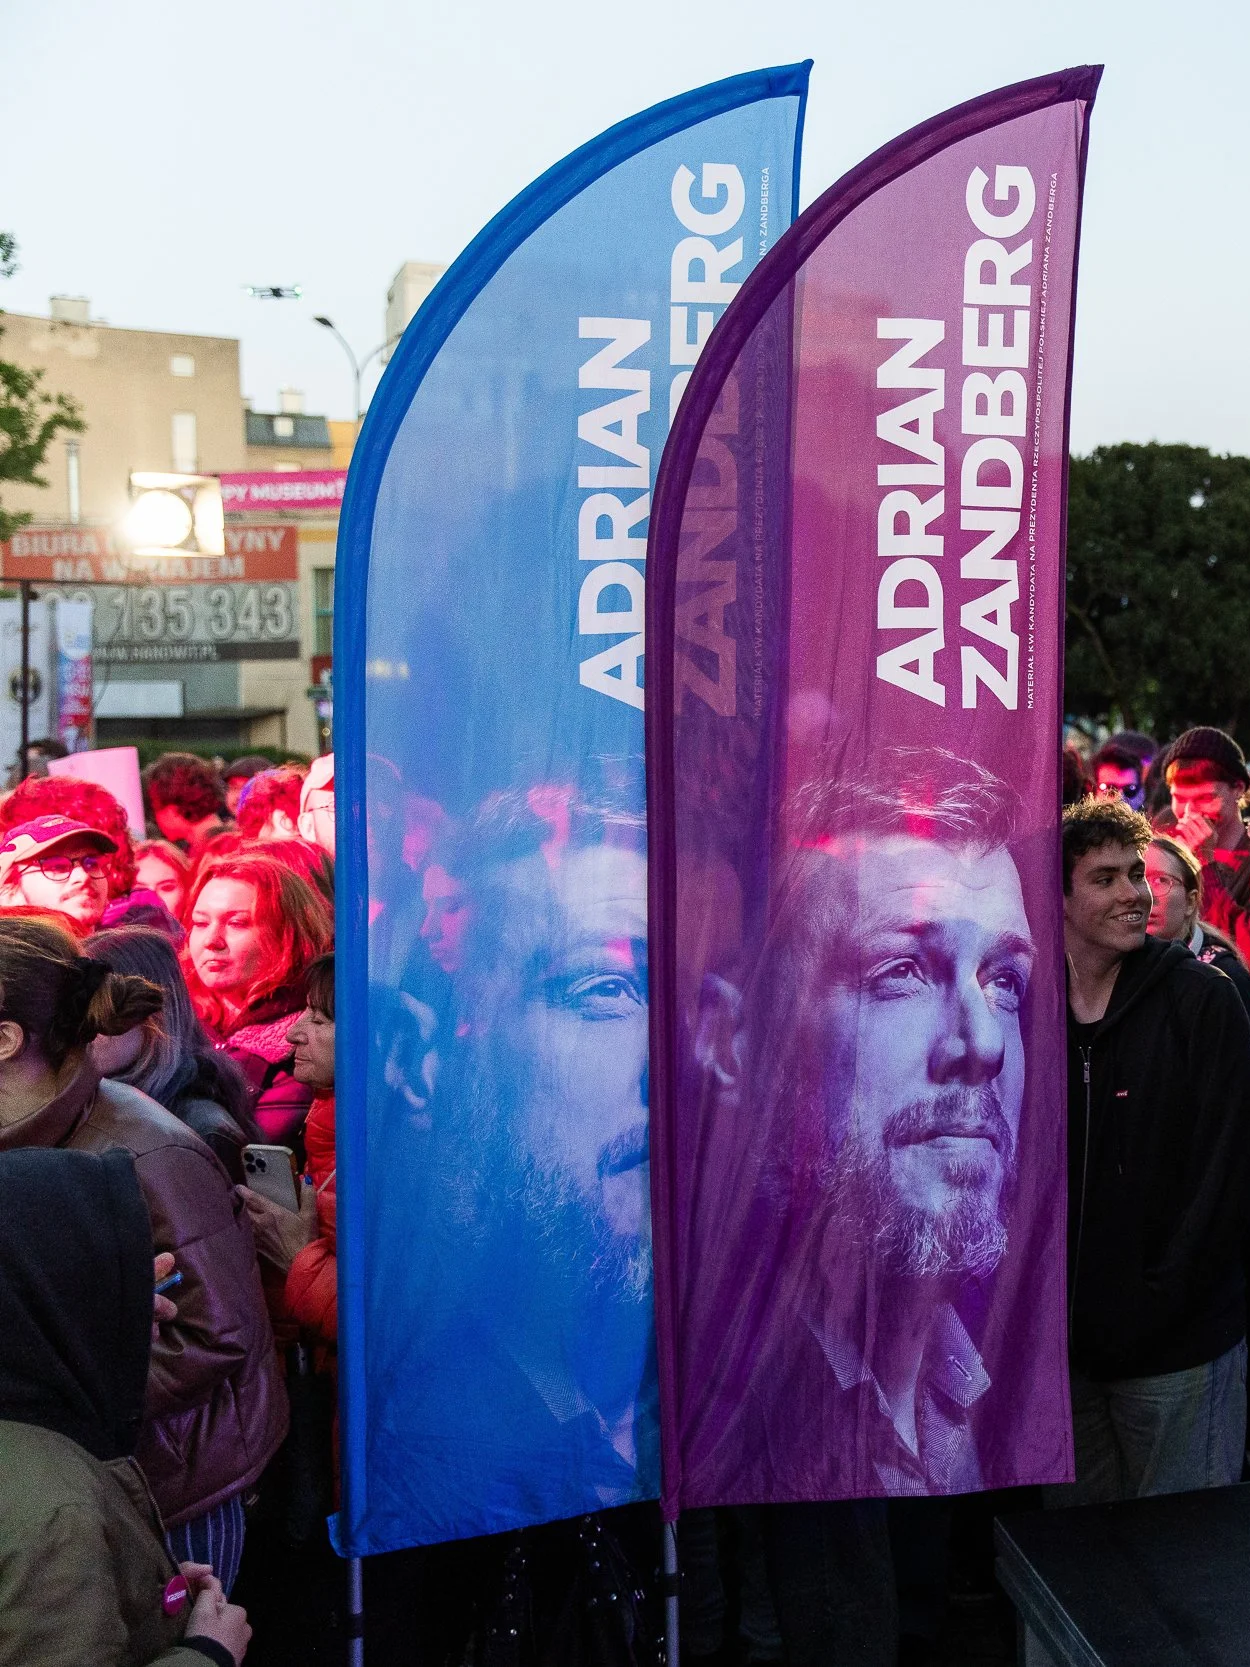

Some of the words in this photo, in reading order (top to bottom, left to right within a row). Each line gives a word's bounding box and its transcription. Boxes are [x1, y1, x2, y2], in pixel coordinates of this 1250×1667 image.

[759, 167, 770, 236] ZANDBERGA
[1046, 172, 1058, 243] ZANDBERGA
[1041, 247, 1050, 298] ADRIANA
[1038, 301, 1047, 354] POLSKIEJ
[960, 164, 1036, 710] ZANDBERG
[1031, 356, 1044, 466] RZECZYPOSPOLITEJ
[578, 317, 651, 712] ADRIAN
[876, 317, 945, 708] ADRIAN
[1029, 470, 1038, 542] PREZYDENTA
[102, 556, 245, 580] WNAJEM
[1029, 545, 1036, 561] NA
[209, 587, 291, 636] 343
[1028, 562, 1036, 631] KANDYDATA
[1028, 633, 1035, 648] KW
[1027, 652, 1035, 709] MATERIAŁ
